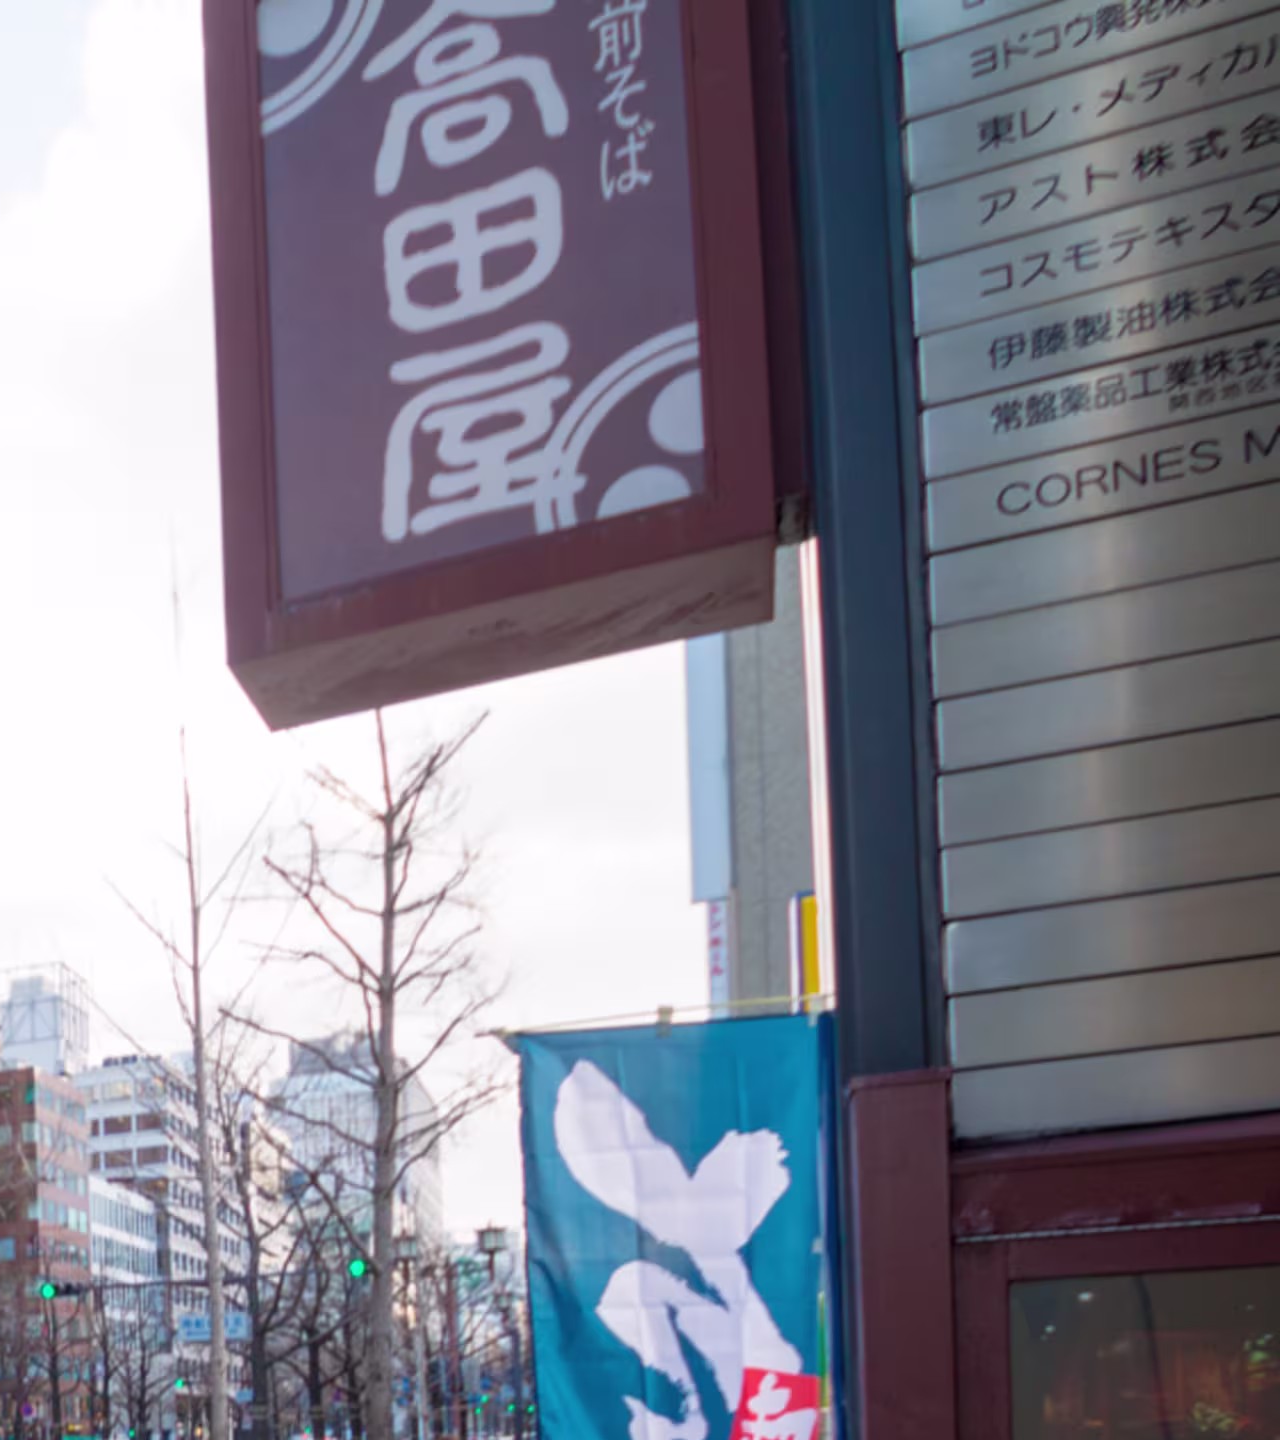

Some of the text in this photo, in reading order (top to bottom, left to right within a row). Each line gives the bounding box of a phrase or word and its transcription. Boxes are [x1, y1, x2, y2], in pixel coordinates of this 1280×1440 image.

[991, 339, 1280, 434] 常盤薬品工業株式
[997, 439, 1221, 515] CORNES
